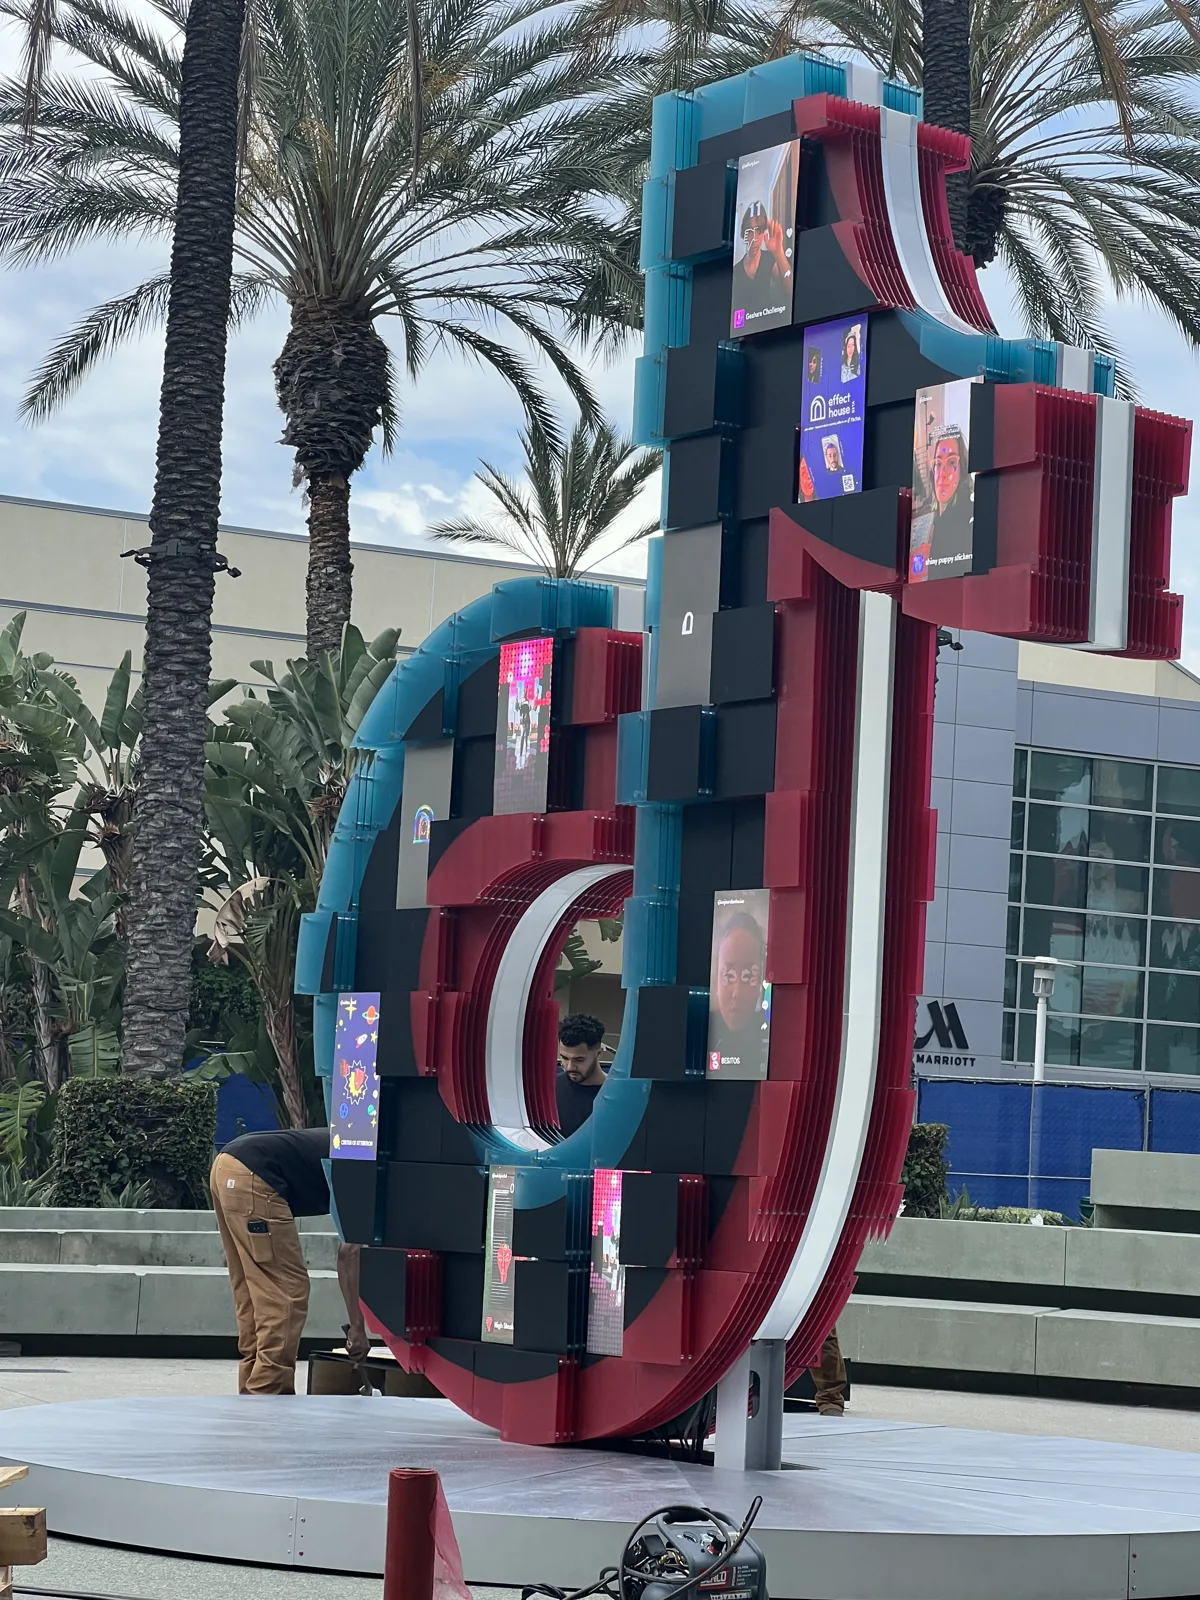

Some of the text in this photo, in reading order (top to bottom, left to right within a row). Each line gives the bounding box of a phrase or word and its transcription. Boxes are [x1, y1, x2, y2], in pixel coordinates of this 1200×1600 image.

[745, 305, 786, 320] Gesture Challenge
[828, 392, 851, 407] effect
[828, 406, 851, 418] house
[925, 556, 938, 566] shiny
[938, 556, 954, 566] puppy
[720, 1056, 741, 1065] BESITOS
[916, 1053, 976, 1067] MARRIOTT
